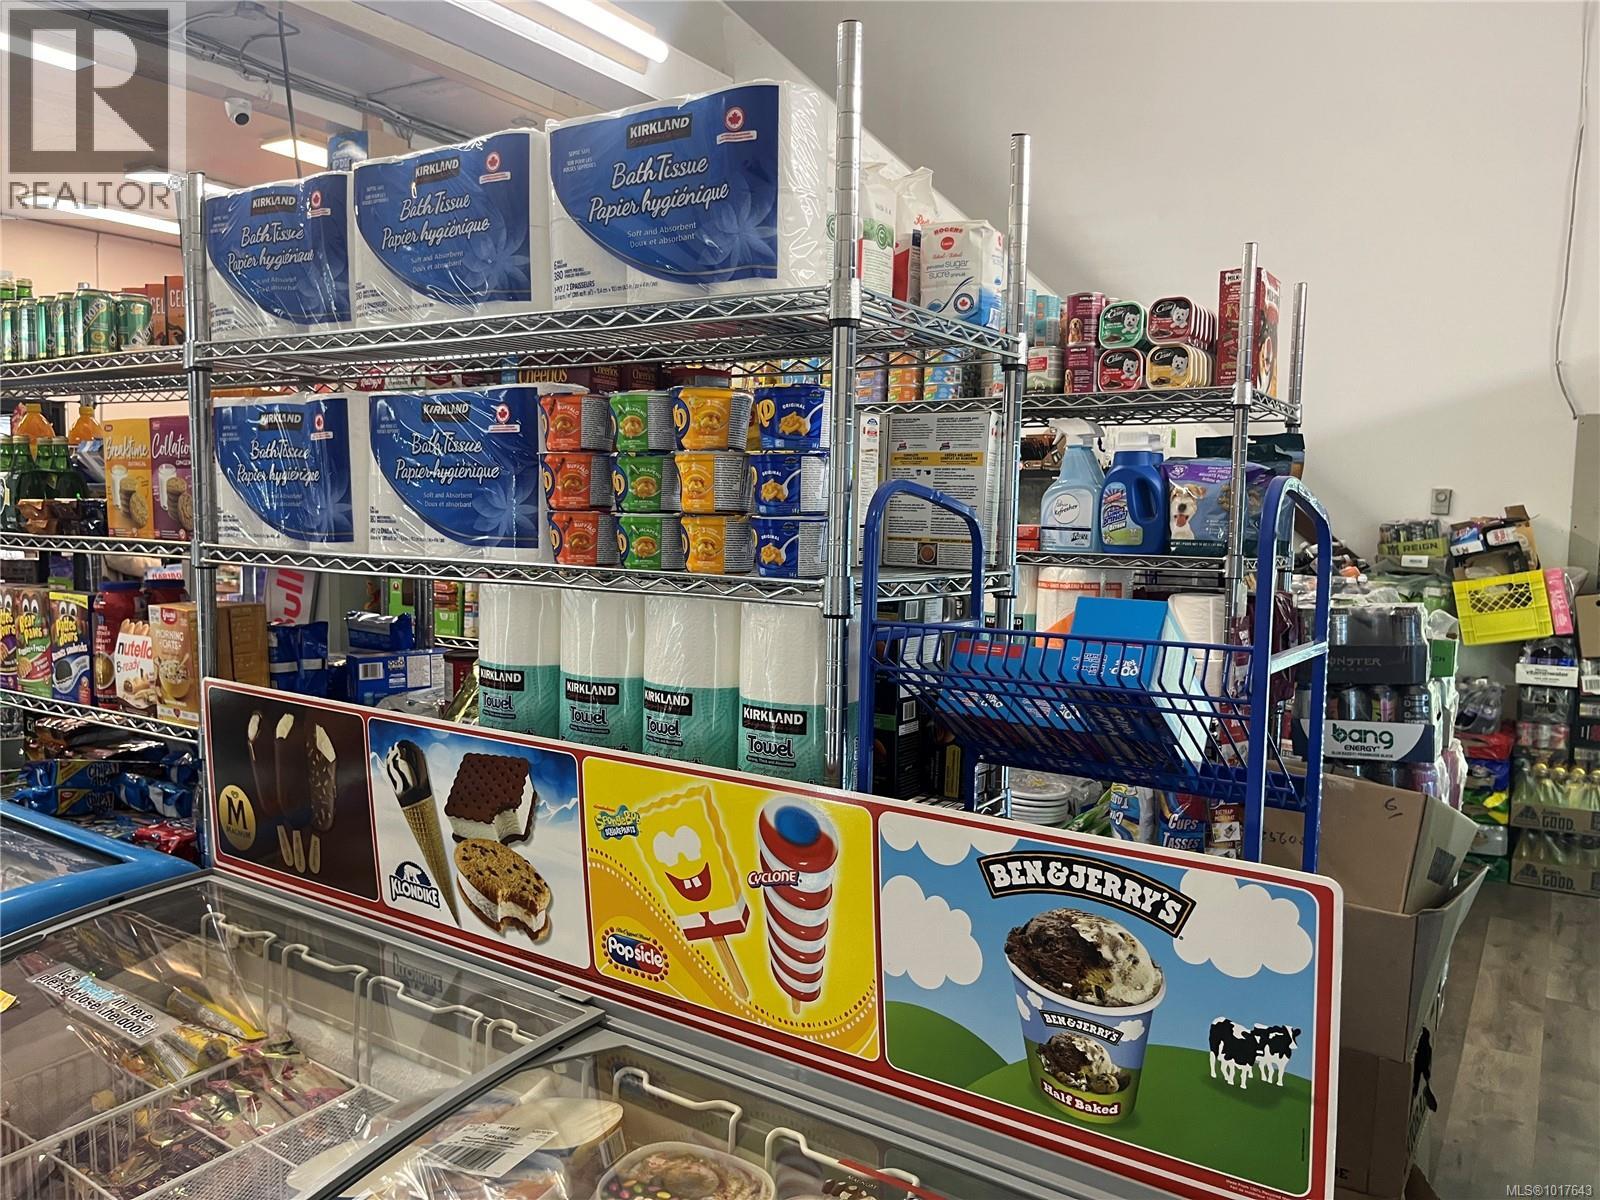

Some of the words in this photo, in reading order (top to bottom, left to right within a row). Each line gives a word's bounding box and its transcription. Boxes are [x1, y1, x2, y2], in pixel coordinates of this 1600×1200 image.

[630, 117, 690, 139] KIRKLAND
[415, 158, 460, 178] KIRKLAND
[611, 156, 656, 190] Bath
[656, 153, 709, 180] Tissue
[252, 195, 296, 209] KIRKLAND
[400, 194, 435, 222] Bath
[433, 191, 471, 216] Tissue
[588, 197, 640, 226] Papier
[640, 183, 730, 219] hygiénique
[241, 223, 272, 247] Bath
[271, 222, 305, 243] Tissue
[381, 227, 421, 253] Papier
[420, 216, 491, 246] hygiénique
[627, 229, 642, 238] Soft
[643, 228, 658, 237] and
[659, 221, 697, 234] Absorbent
[648, 238, 657, 247] et
[657, 232, 696, 246] absorbant
[227, 252, 258, 274] Papier
[260, 413, 301, 425] KIRKLAND
[423, 403, 469, 415] KIRKLAND
[250, 440, 276, 460] Bath
[277, 439, 310, 459] Tissue
[411, 429, 442, 455] Bath
[443, 432, 482, 454] Tissue
[237, 464, 268, 487] Papier
[395, 459, 432, 484] Papier
[432, 458, 500, 485] hygiénique
[1403, 542, 1438, 553] REIGN
[117, 640, 152, 660] nutella
[1328, 656, 1381, 667] ONSTER
[480, 668, 521, 683] KIRKLAND
[566, 681, 617, 696] KIRKLAND
[645, 689, 690, 707] KIRKLAND
[483, 692, 513, 709] Towel
[570, 706, 608, 724] Towel
[743, 707, 804, 725] KIRKLAND
[646, 716, 681, 736] Towel
[1331, 723, 1393, 749] bang
[747, 734, 793, 757] Towel
[1344, 744, 1378, 752] ENERGY
[228, 795, 248, 831] M
[1168, 813, 1199, 830] CUPS
[1162, 832, 1201, 849] TASSES
[748, 871, 798, 887] CYCLONE
[390, 875, 440, 907] KLONDIKE
[990, 860, 1182, 925] BEN&JERRY'S
[608, 936, 664, 968] Popsicle
[58, 968, 79, 983] It's
[111, 994, 128, 1009] in
[33, 973, 73, 997] please
[68, 991, 101, 1012] close
[97, 1006, 118, 1022] the
[115, 1016, 157, 1039] door!
[1043, 1013, 1120, 1043] BEN&JERRY'S
[1043, 1083, 1075, 1107] Half
[1075, 1097, 1119, 1116] Baked
